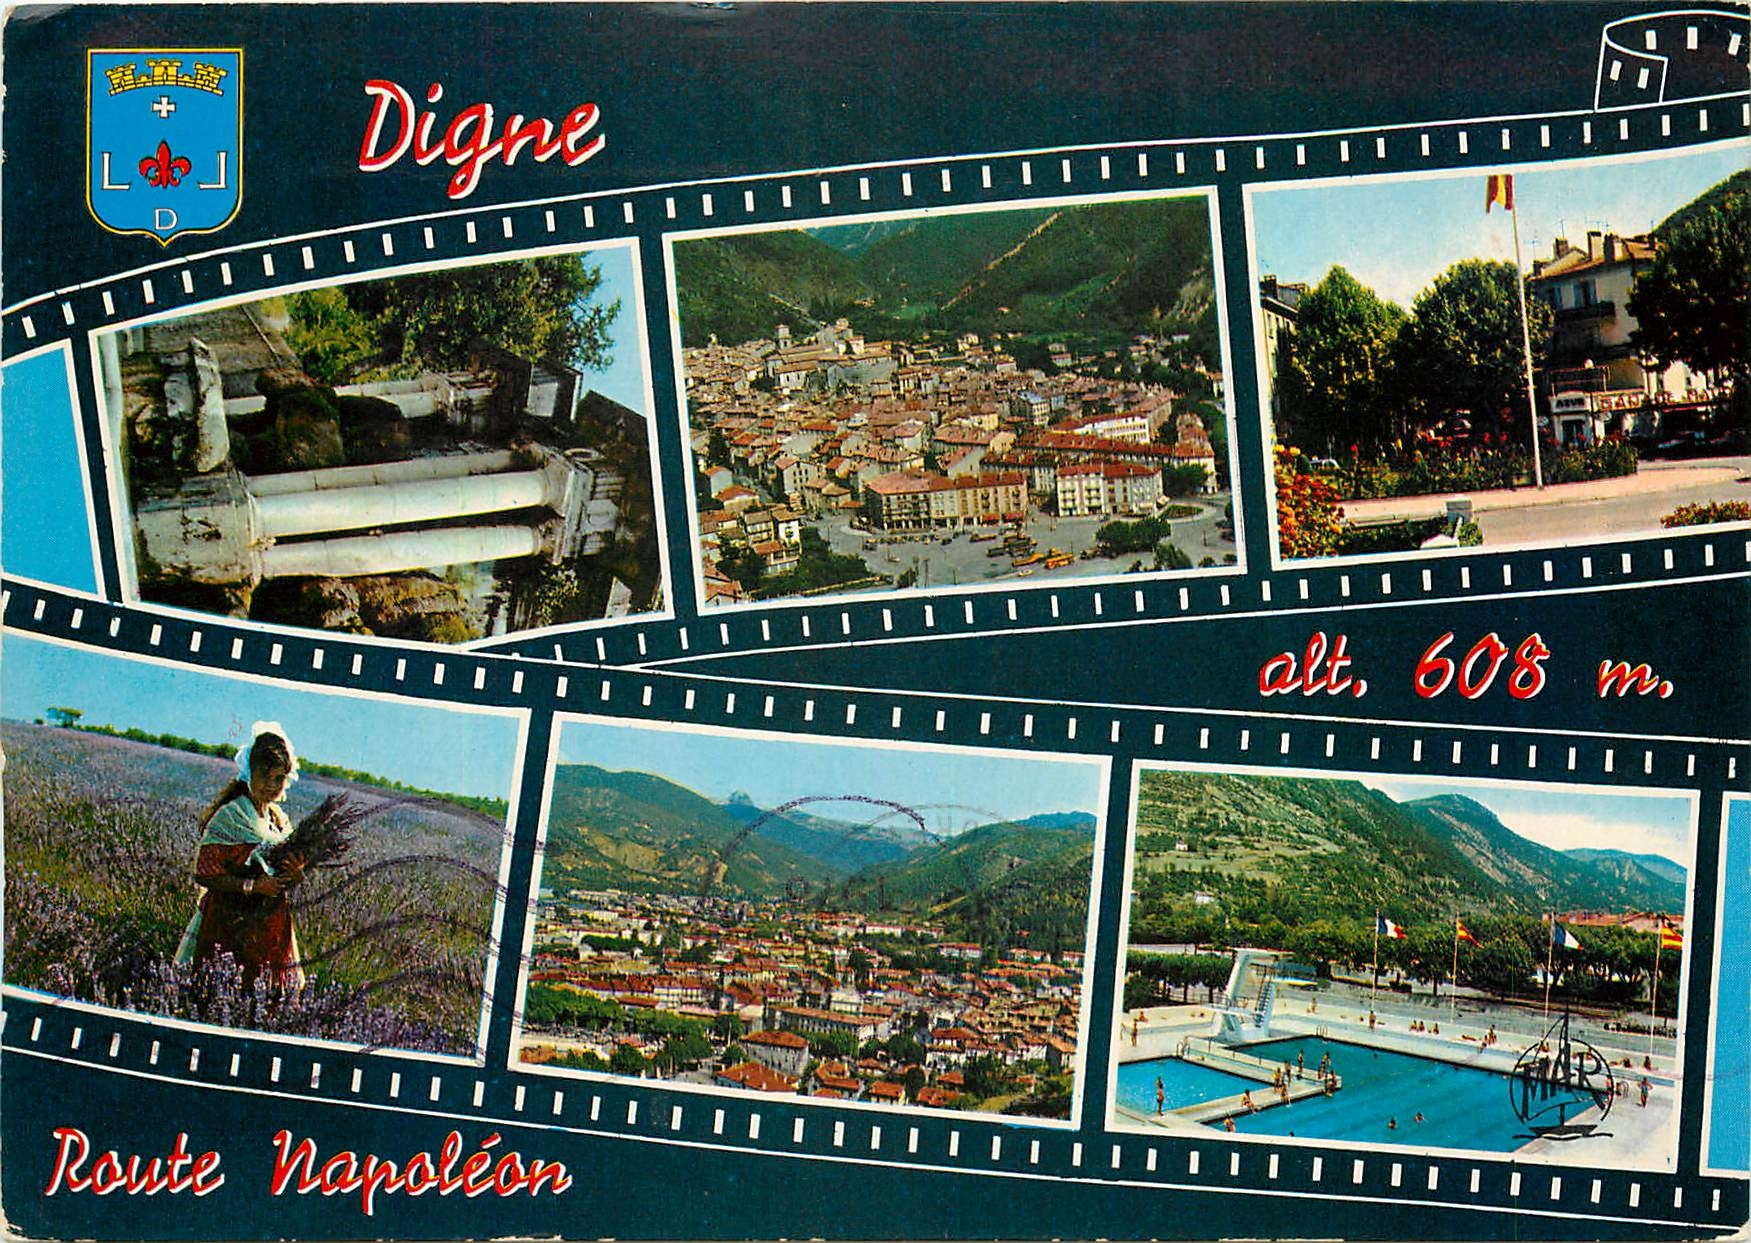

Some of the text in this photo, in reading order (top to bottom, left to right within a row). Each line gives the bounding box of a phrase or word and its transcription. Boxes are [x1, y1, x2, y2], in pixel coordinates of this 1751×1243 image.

[102, 151, 132, 190] L
[359, 79, 606, 199] Digne
[154, 207, 178, 231] D
[1258, 631, 1675, 699] alt. 608 m.
[45, 1127, 573, 1217] Route Napoléon
